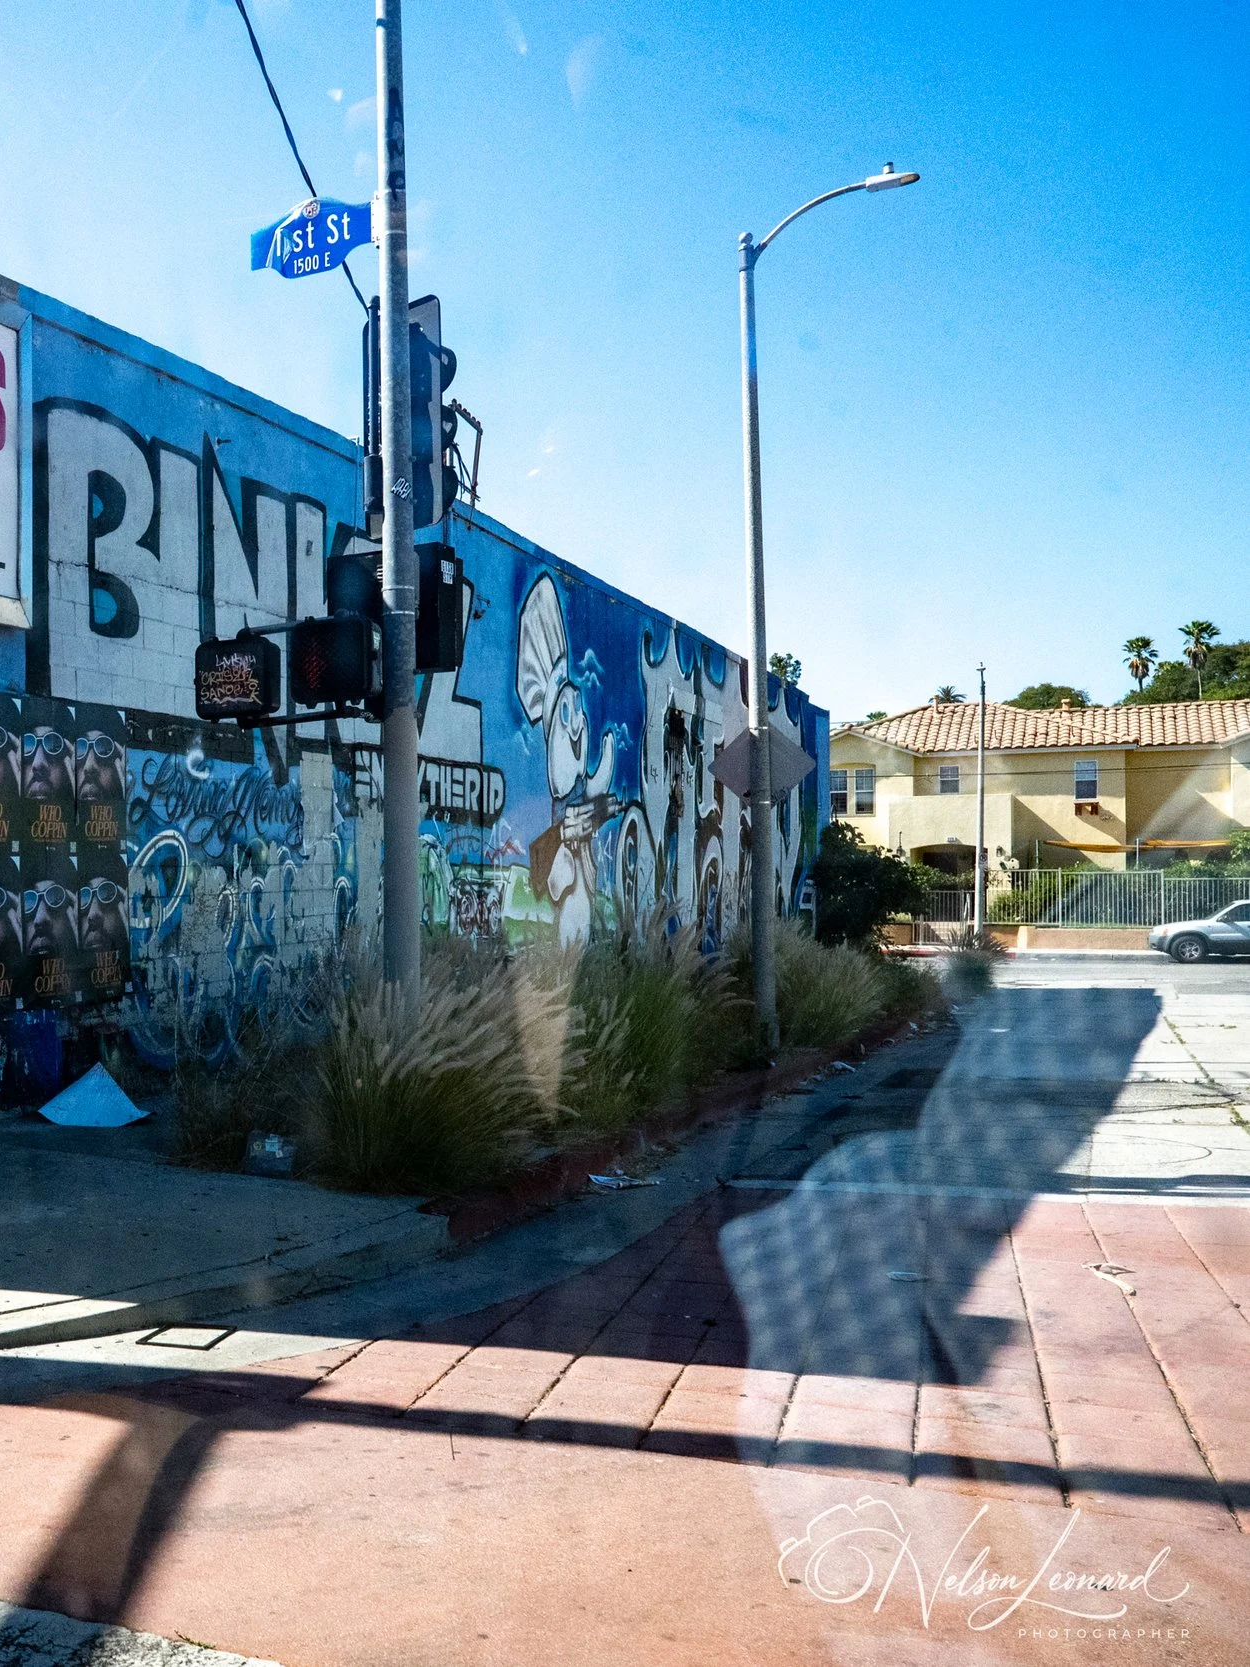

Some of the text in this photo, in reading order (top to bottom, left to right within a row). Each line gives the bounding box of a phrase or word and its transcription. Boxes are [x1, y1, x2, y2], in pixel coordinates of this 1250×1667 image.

[276, 212, 351, 257] 1st St
[293, 252, 331, 275] 1500 E
[39, 805, 62, 821] WHO
[91, 805, 113, 820] WHO
[31, 821, 67, 838] COPPIN
[85, 821, 118, 837] COPPIN
